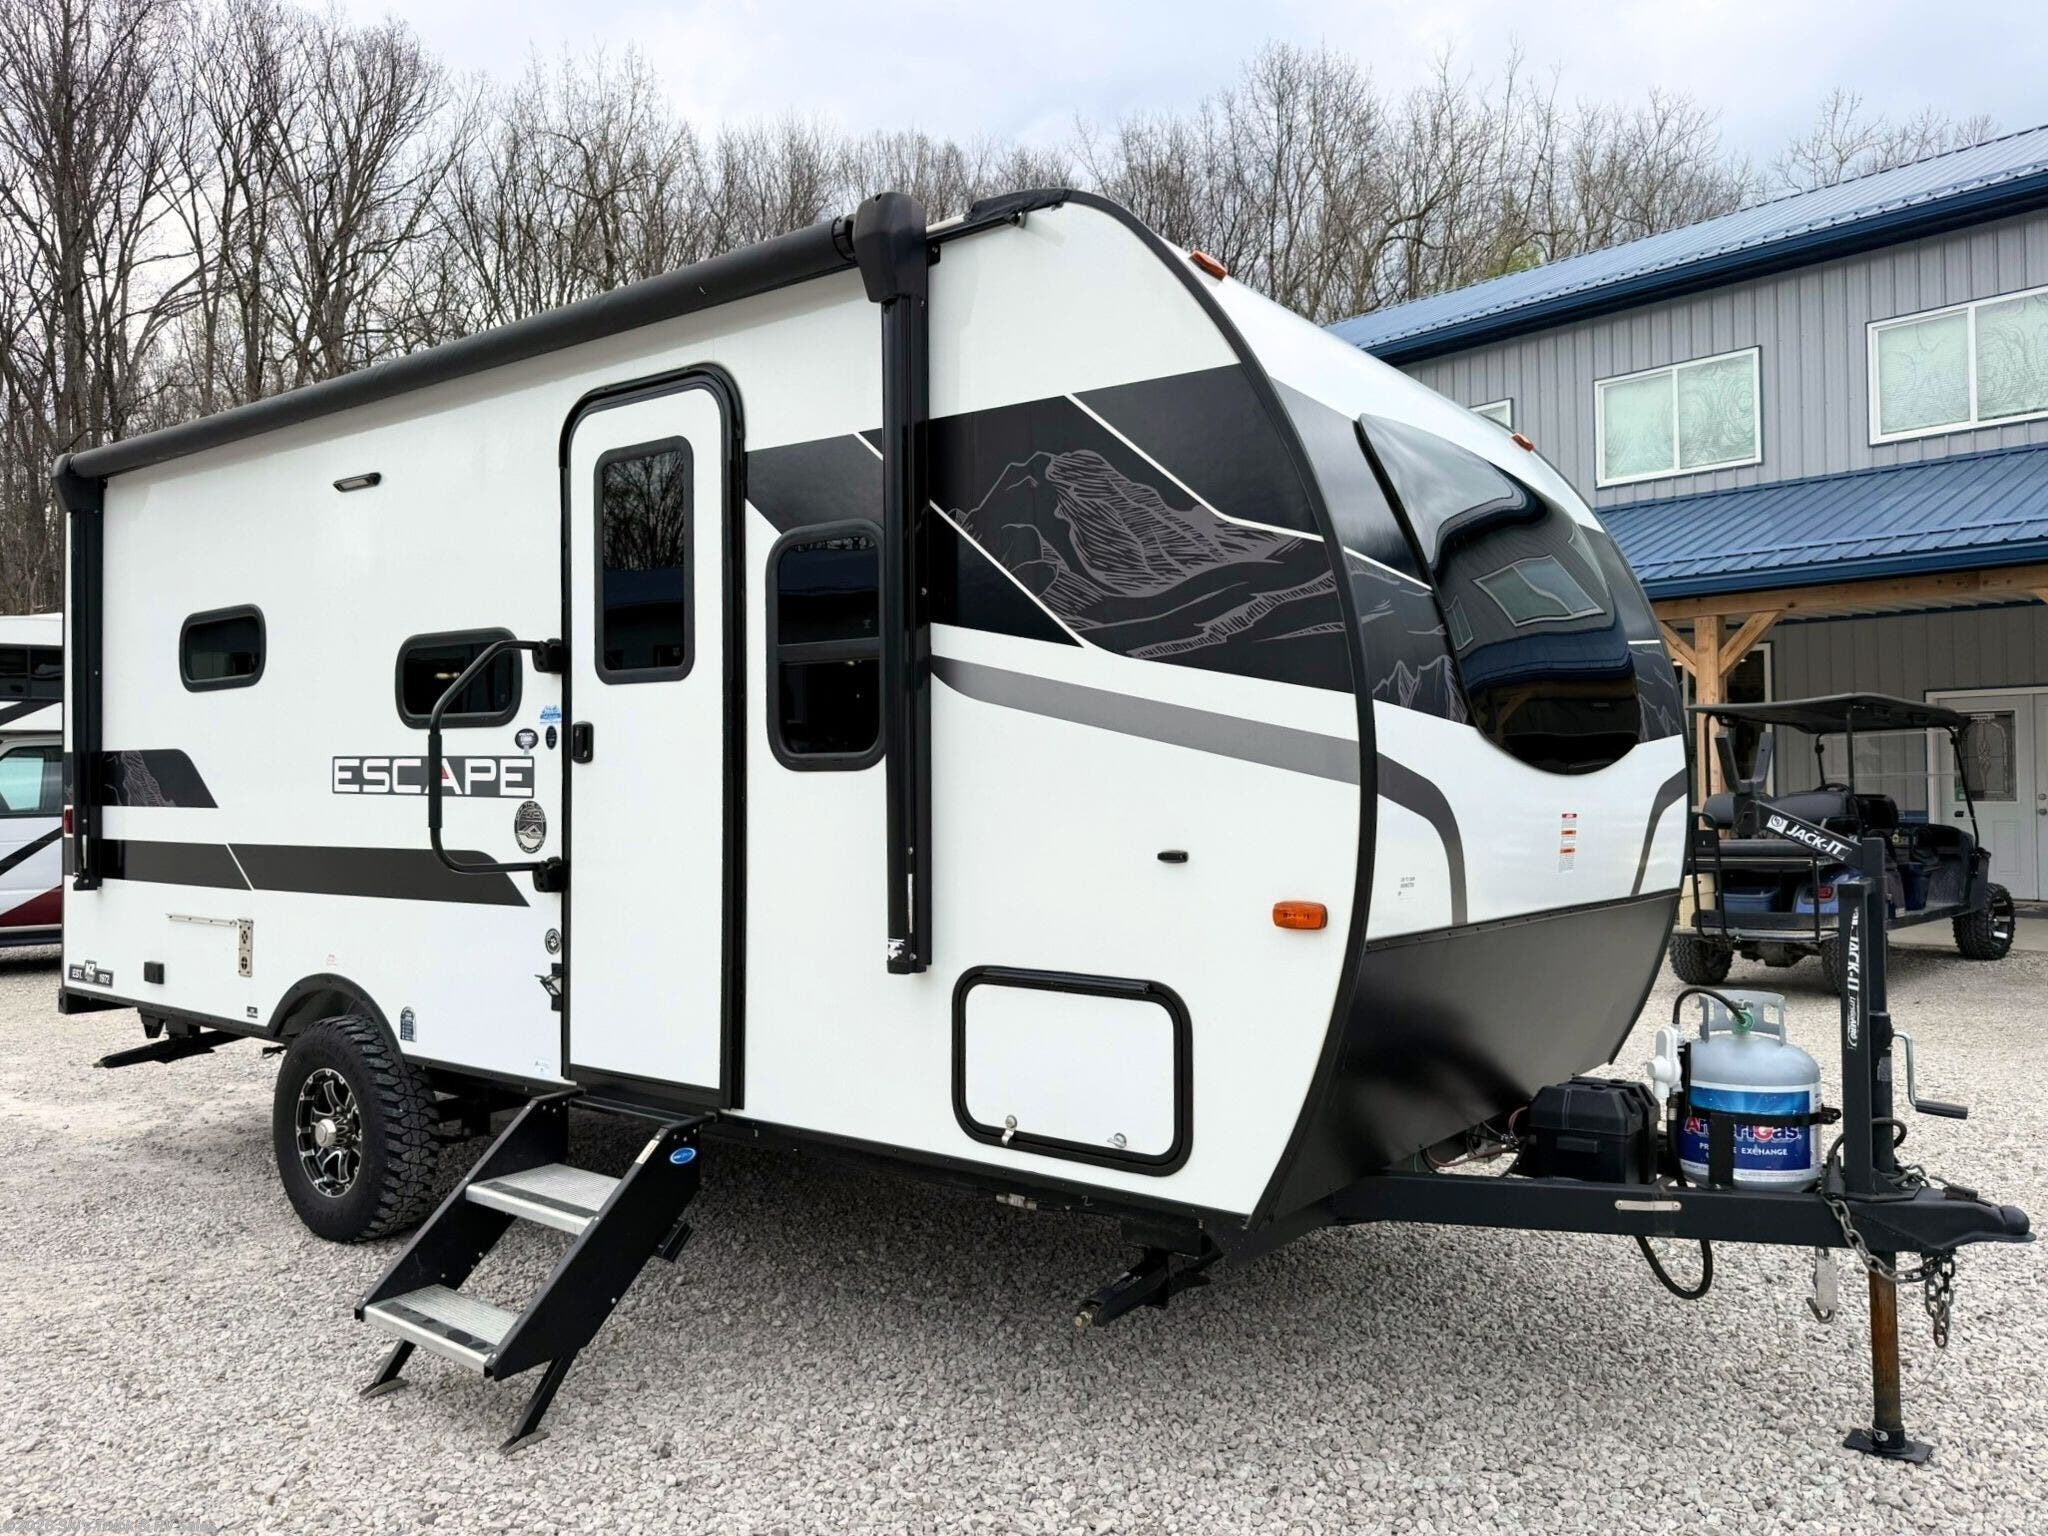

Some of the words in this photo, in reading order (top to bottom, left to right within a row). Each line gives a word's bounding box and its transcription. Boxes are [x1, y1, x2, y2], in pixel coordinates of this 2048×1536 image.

[334, 758, 533, 797] ESCAPE
[1786, 824, 1846, 856] JACK-IT
[1684, 1117, 1801, 1142] AriGas
[1741, 1147, 1788, 1156] EXCHANGE
